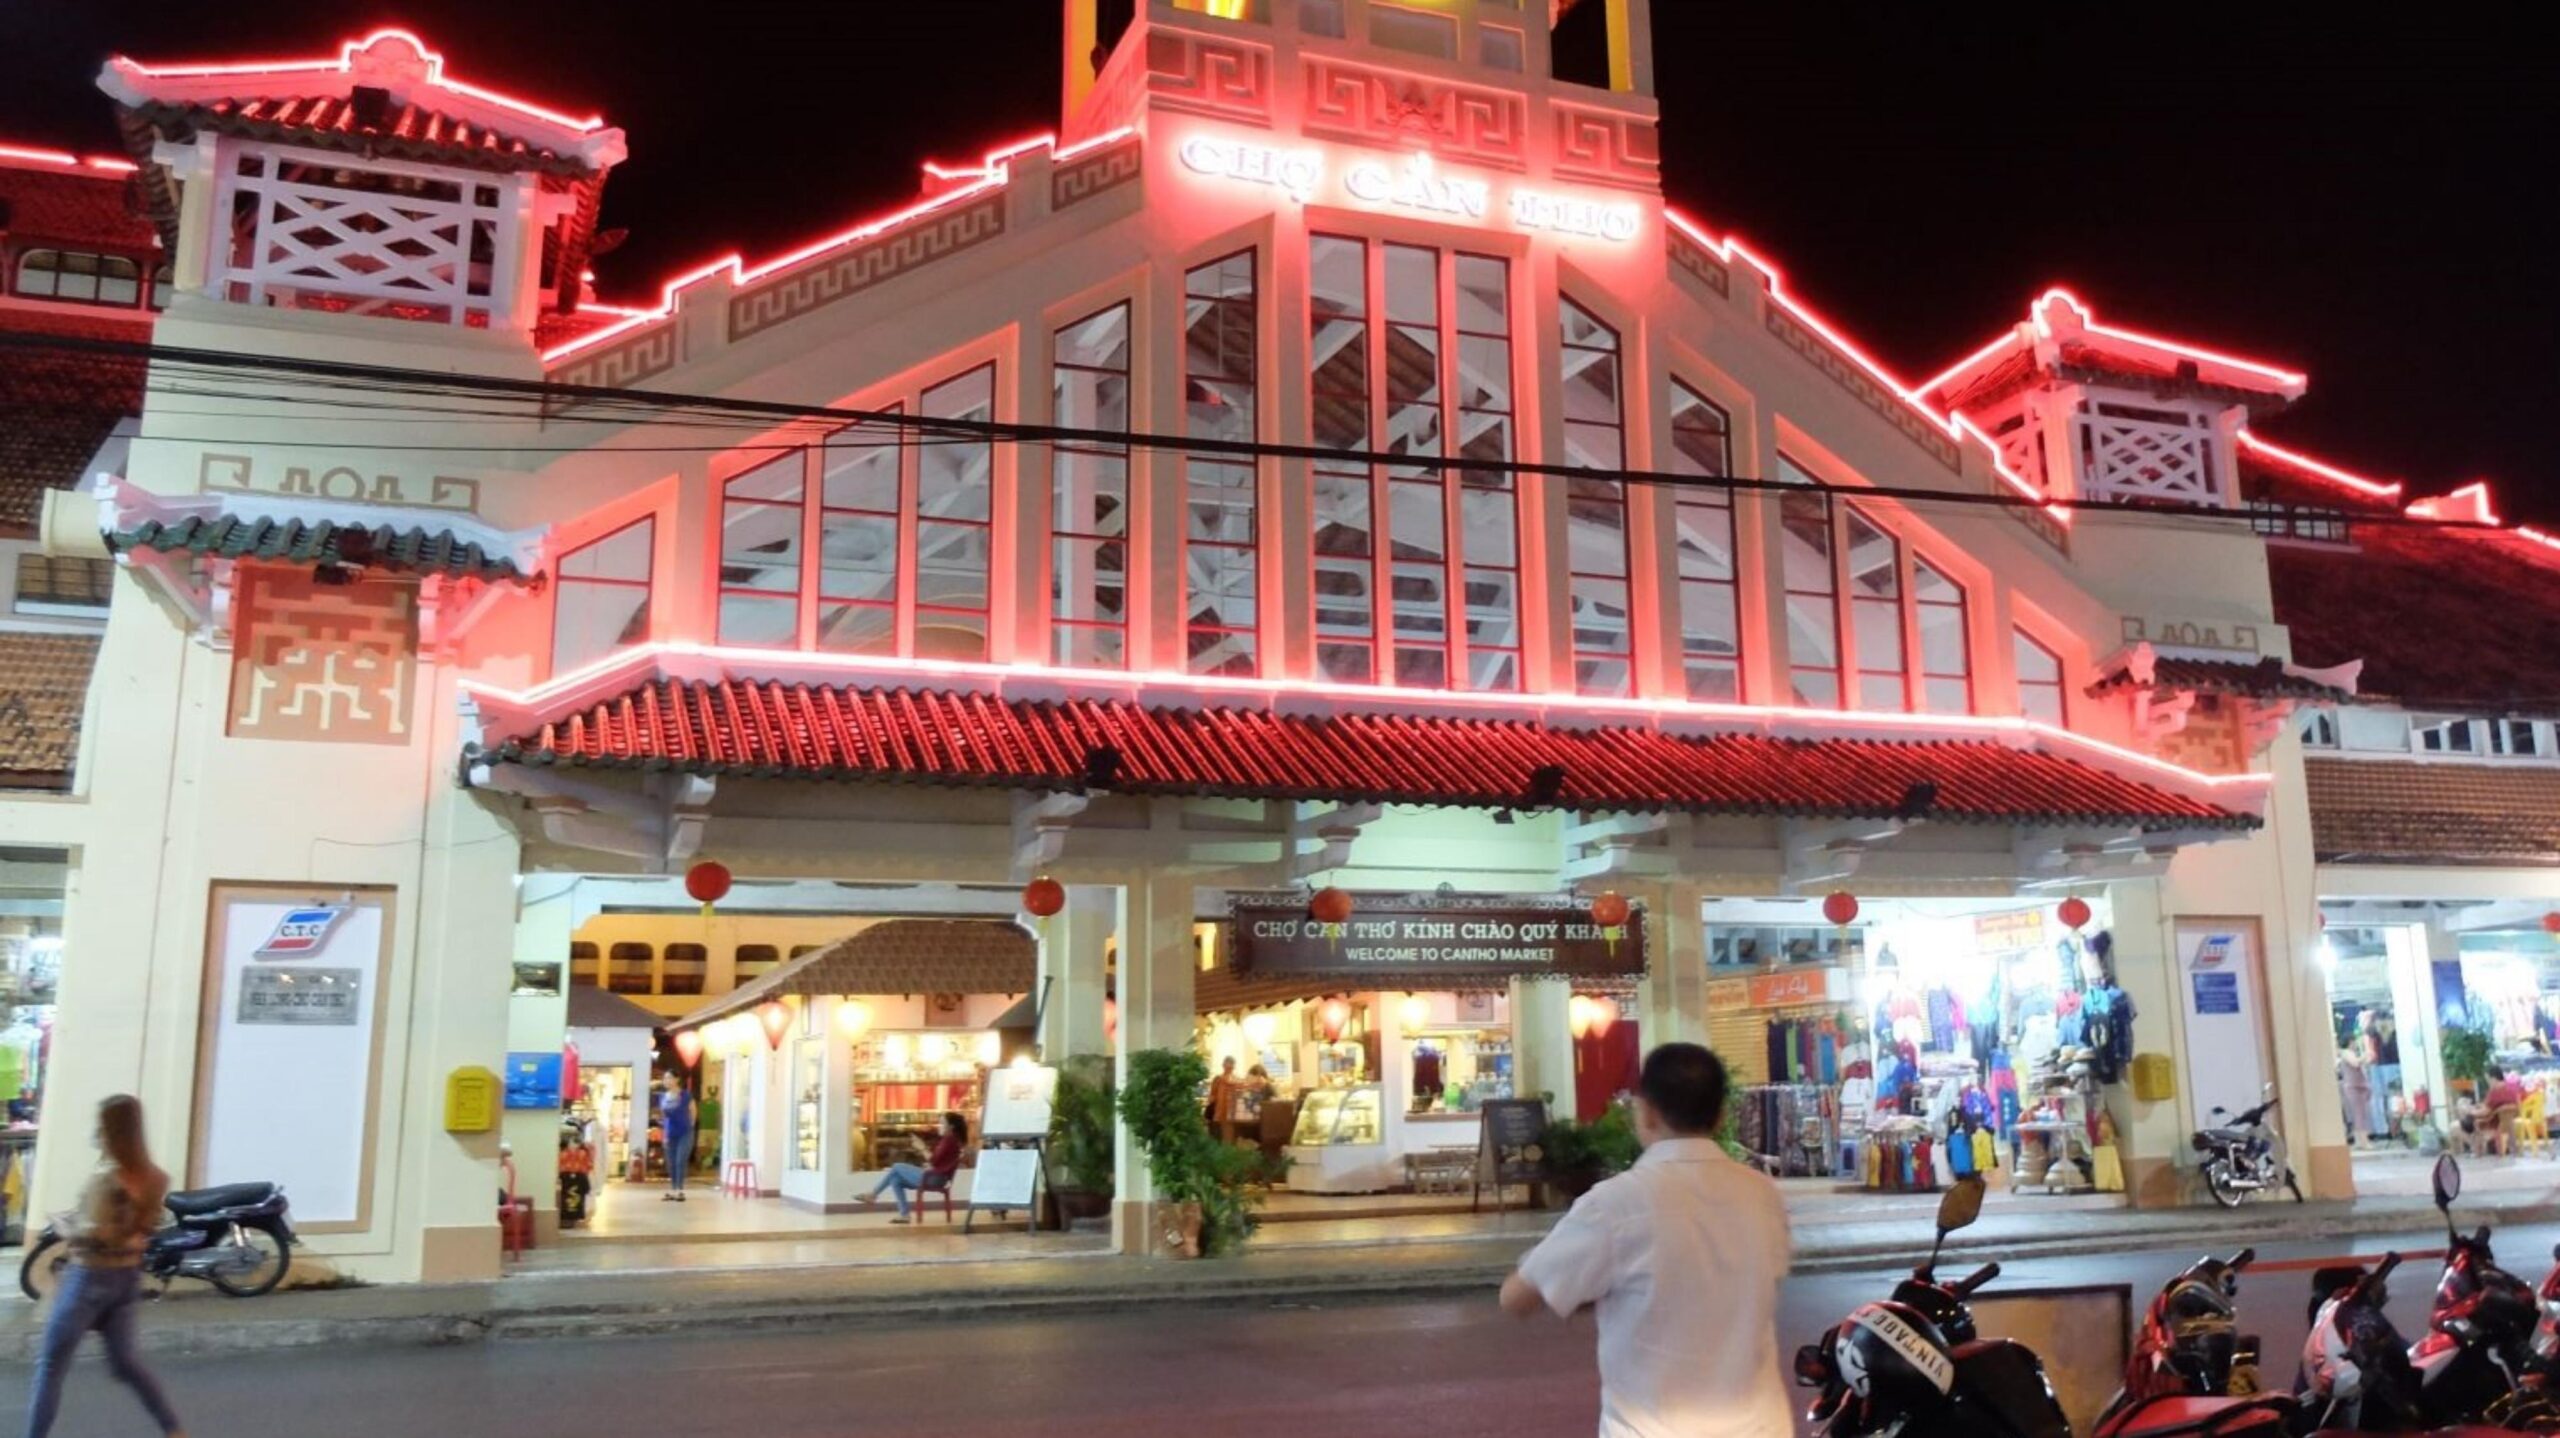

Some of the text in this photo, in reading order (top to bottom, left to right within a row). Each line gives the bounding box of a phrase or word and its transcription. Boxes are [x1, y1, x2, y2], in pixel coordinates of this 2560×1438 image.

[1253, 920, 1298, 943] CHỢ
[1354, 920, 1396, 939] THƠ
[1402, 917, 1455, 939] KÍNH
[1461, 919, 1515, 940] CHÀO
[1519, 920, 1559, 942] QUÝ
[1344, 947, 1555, 961] WELCOME TO CANTHO MARKET
